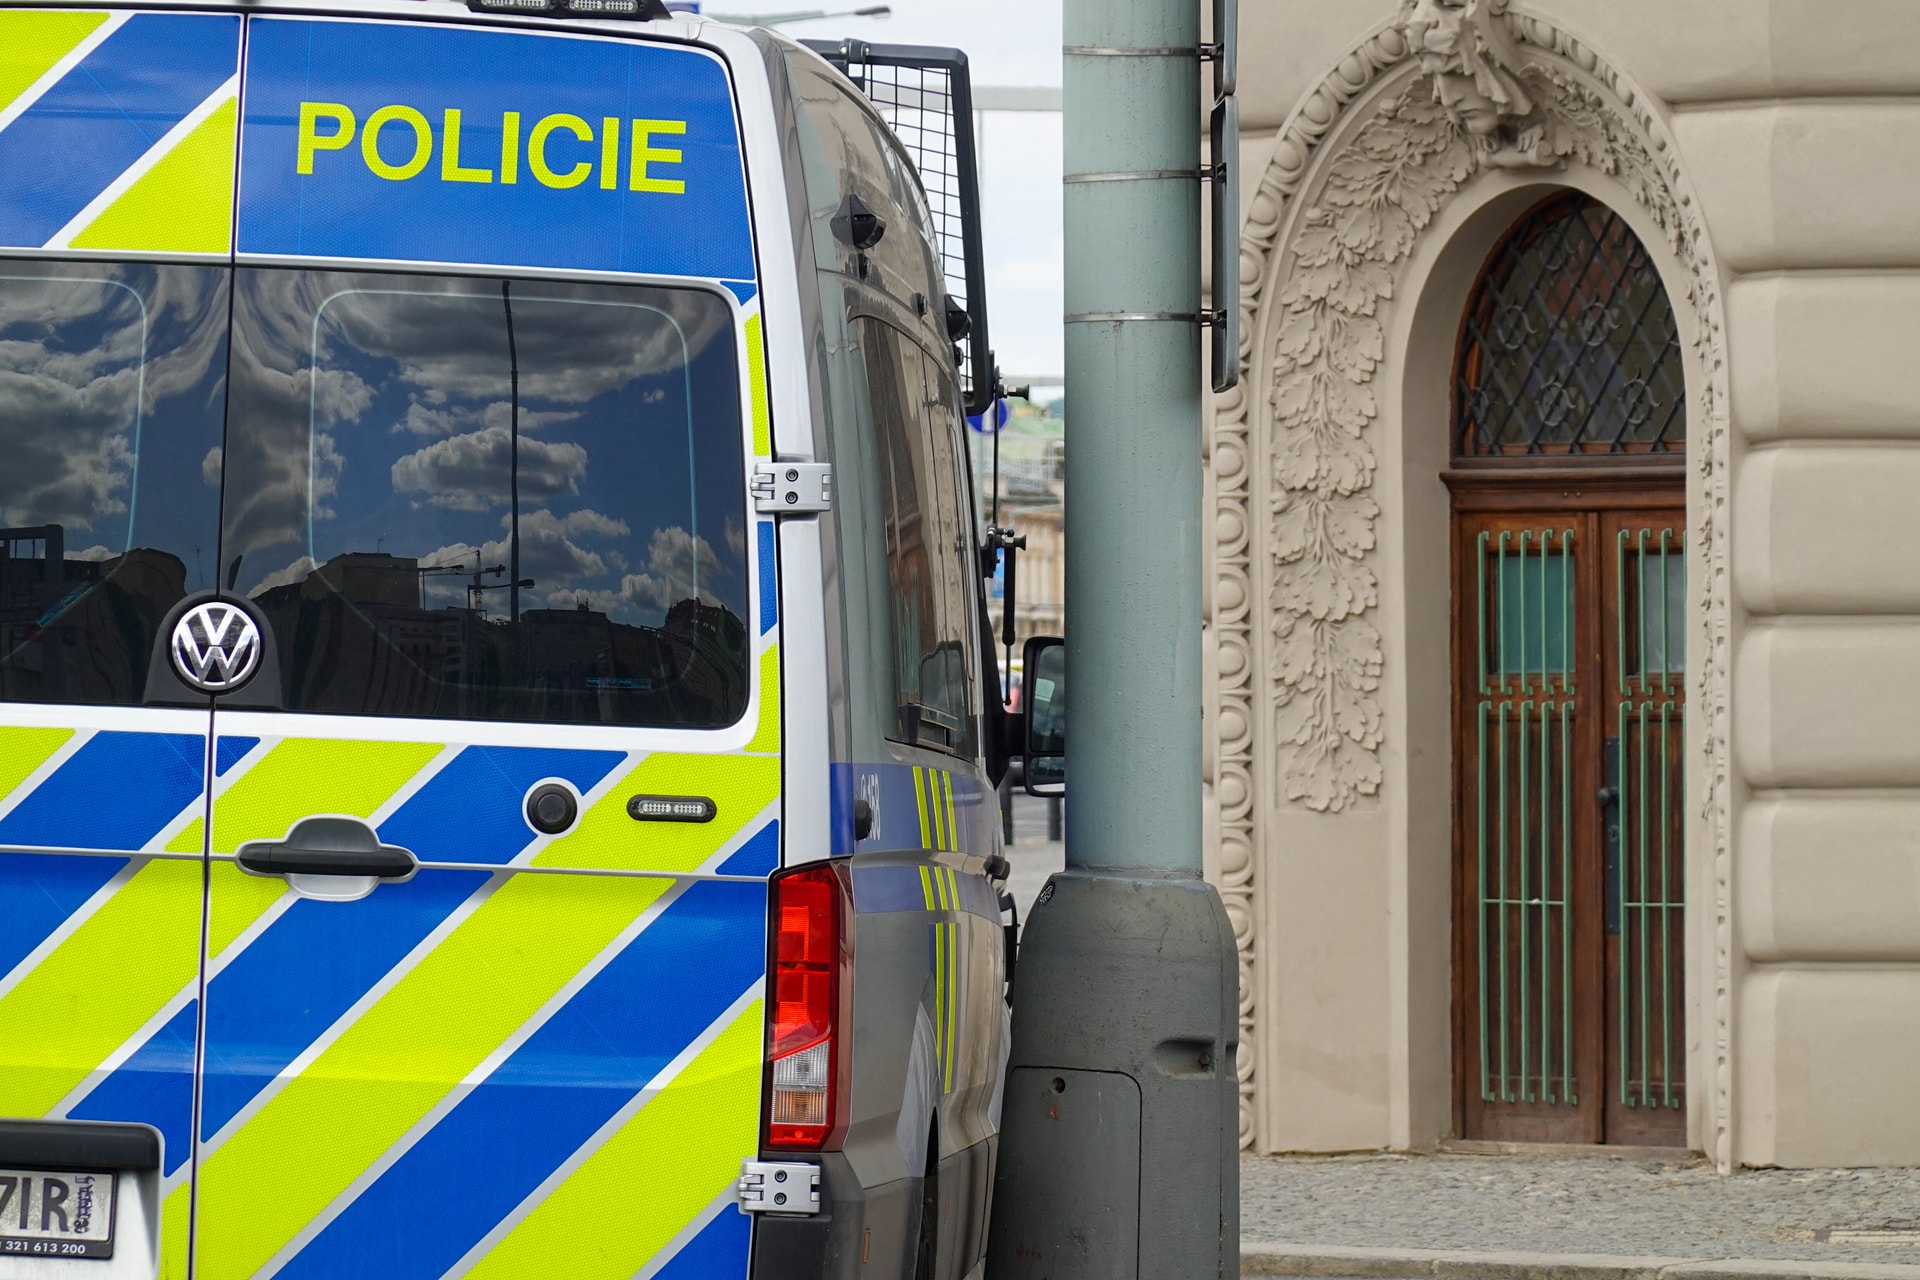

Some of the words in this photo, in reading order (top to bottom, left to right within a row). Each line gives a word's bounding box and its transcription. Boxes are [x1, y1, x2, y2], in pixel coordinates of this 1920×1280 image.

[297, 102, 687, 194] POLICIE
[5, 1240, 28, 1251] 321
[33, 1241, 57, 1253] 613
[62, 1243, 86, 1255] 200
